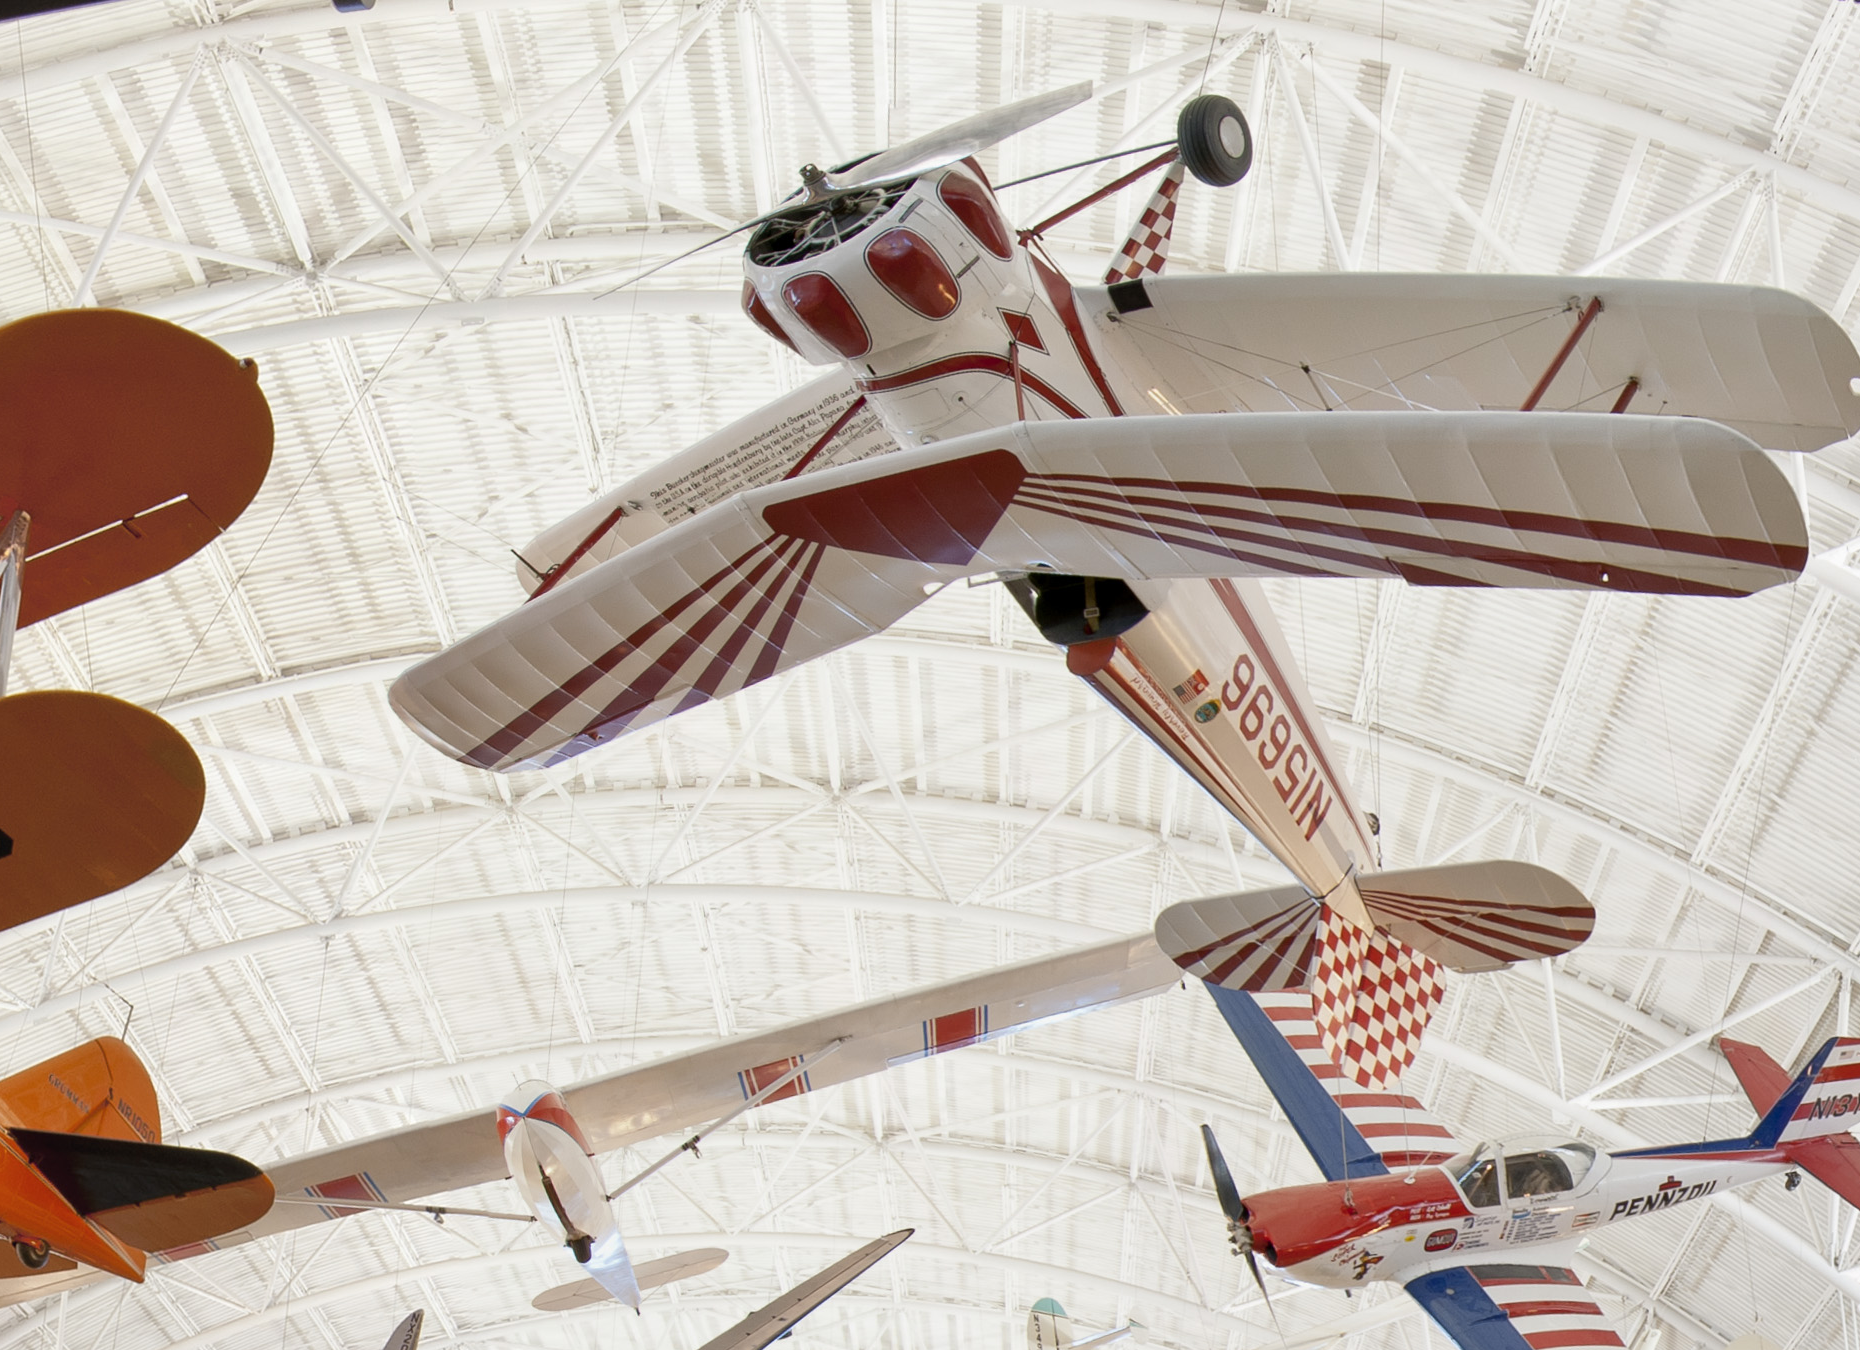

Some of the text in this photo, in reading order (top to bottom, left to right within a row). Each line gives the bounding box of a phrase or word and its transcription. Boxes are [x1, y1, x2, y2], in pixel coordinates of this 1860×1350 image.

[650, 487, 667, 500] This
[727, 450, 738, 458] was
[787, 406, 816, 426] Germany
[839, 387, 854, 398] and
[1221, 653, 1333, 842] N15696
[48, 1073, 91, 1115] GRUMMAN
[1609, 1180, 1717, 1221] PENNZOIL
